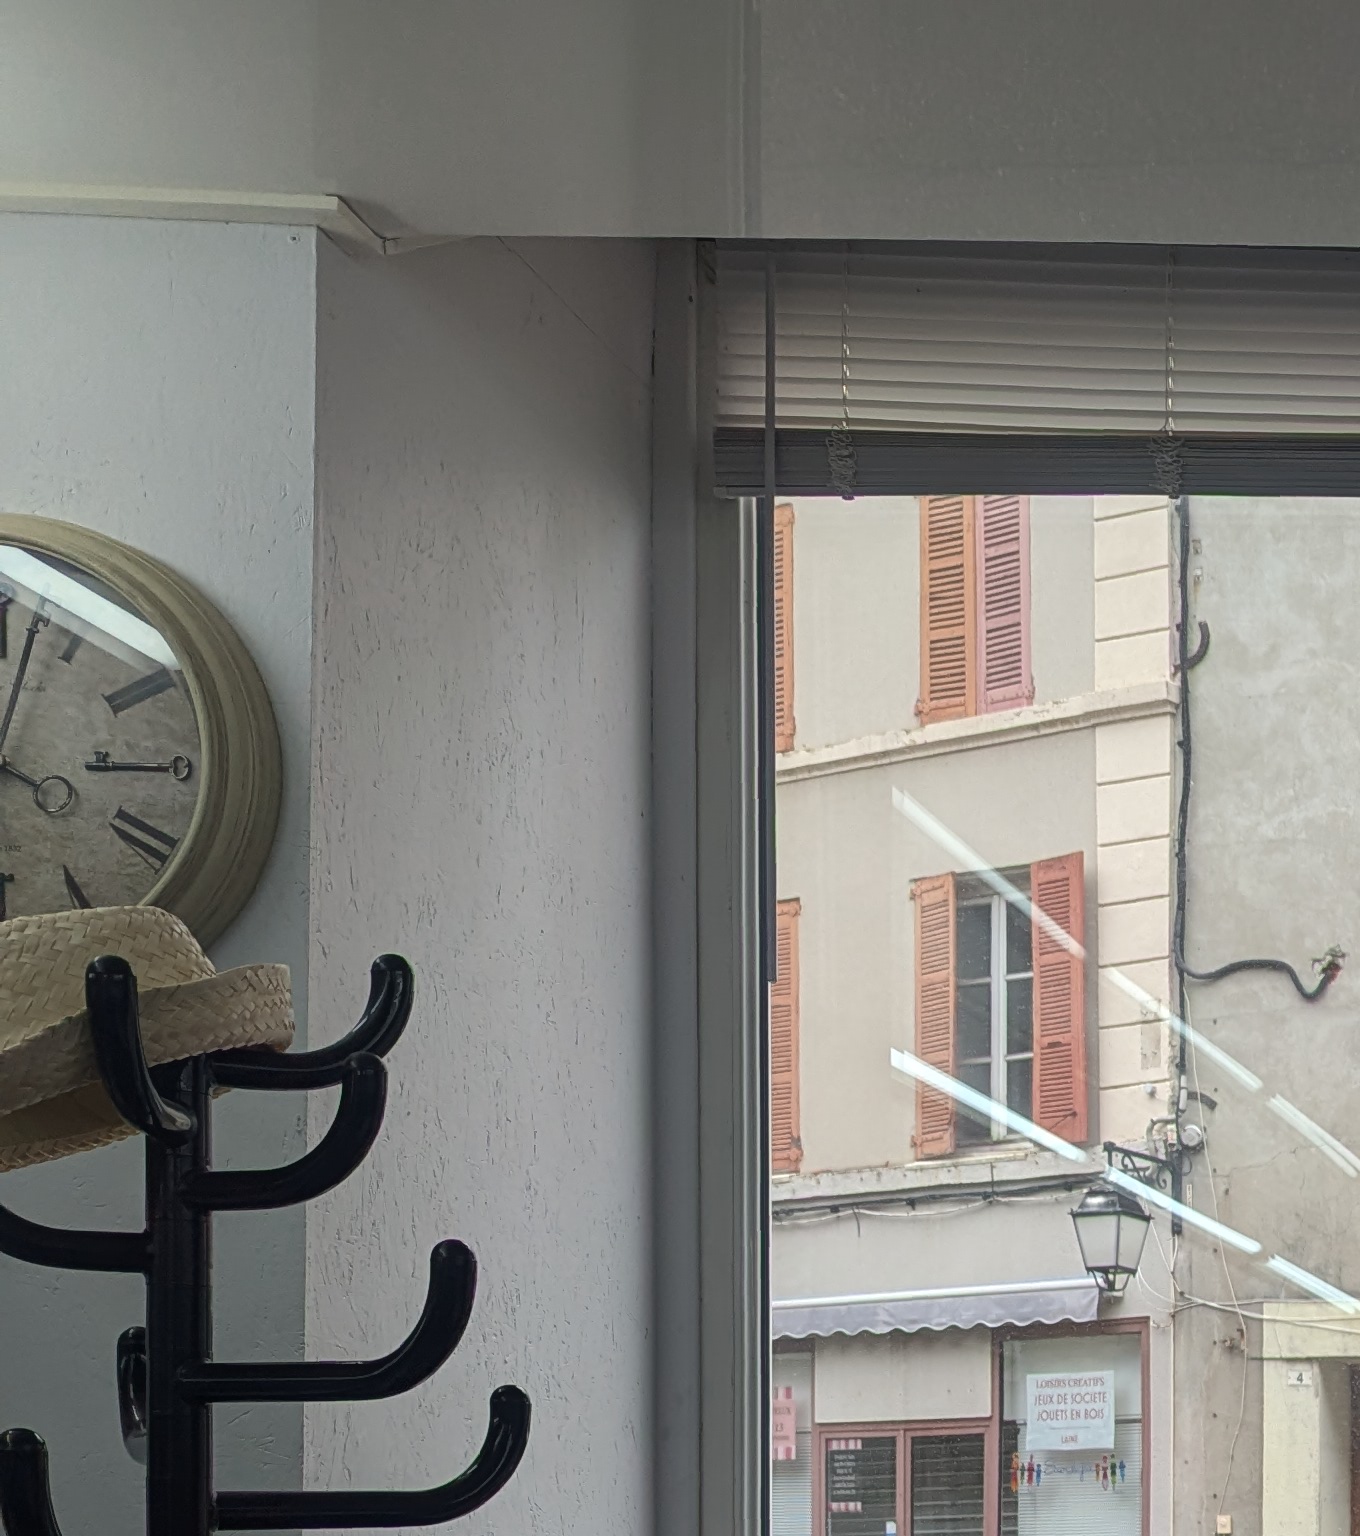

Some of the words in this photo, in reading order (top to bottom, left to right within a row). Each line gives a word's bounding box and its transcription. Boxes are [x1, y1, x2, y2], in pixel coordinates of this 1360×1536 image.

[1296, 1372, 1304, 1384] 4
[1034, 1394, 1054, 1406] JEUX
[1057, 1393, 1068, 1405] DE
[1036, 1408, 1068, 1422] JOUETS
[1070, 1408, 1081, 1420] EN
[1084, 1407, 1105, 1420] BOIS
